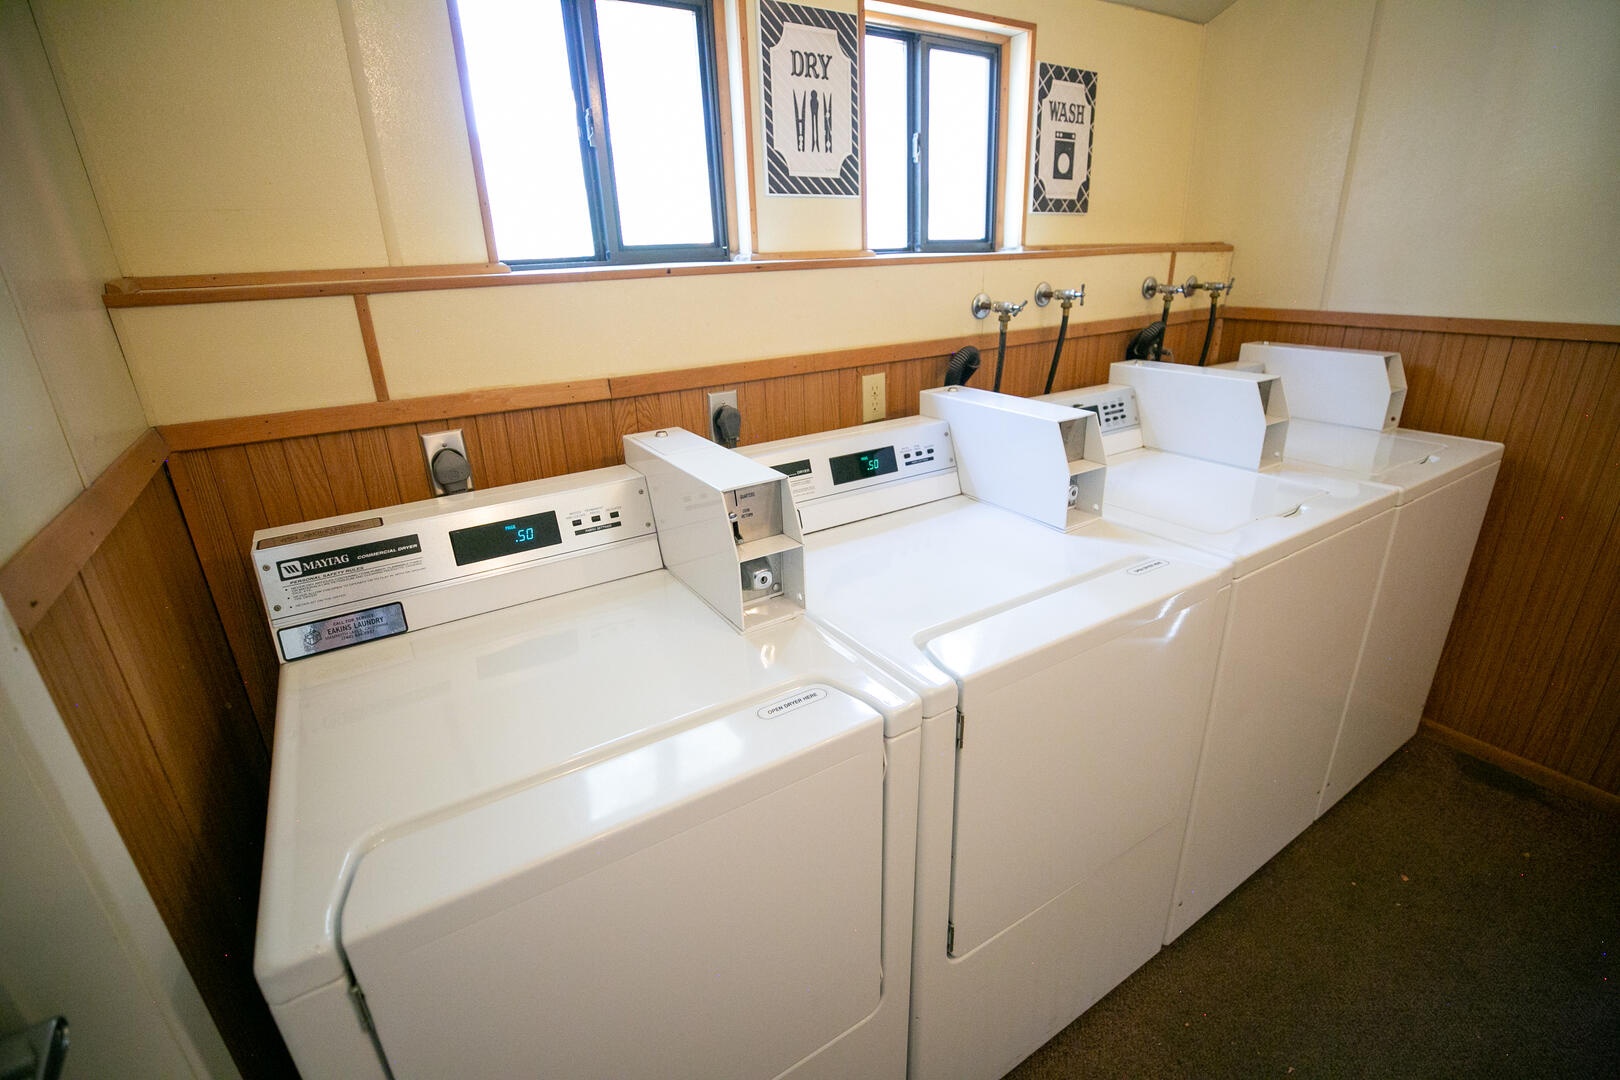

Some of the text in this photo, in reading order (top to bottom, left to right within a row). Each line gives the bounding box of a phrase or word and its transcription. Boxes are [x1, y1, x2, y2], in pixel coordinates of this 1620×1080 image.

[790, 49, 832, 81] DRY
[1049, 100, 1085, 125] WASH
[867, 458, 879, 471] .50
[515, 527, 534, 543] .50
[357, 543, 418, 560] COMMERCIAL DRYER
[302, 554, 350, 572] MAYTAG
[289, 566, 365, 585] PERSONAL SAFETY RULES
[327, 623, 352, 635] EAKINS
[353, 616, 385, 629] LAUNDRY
[767, 692, 818, 715] OPEN DRYER HERE
